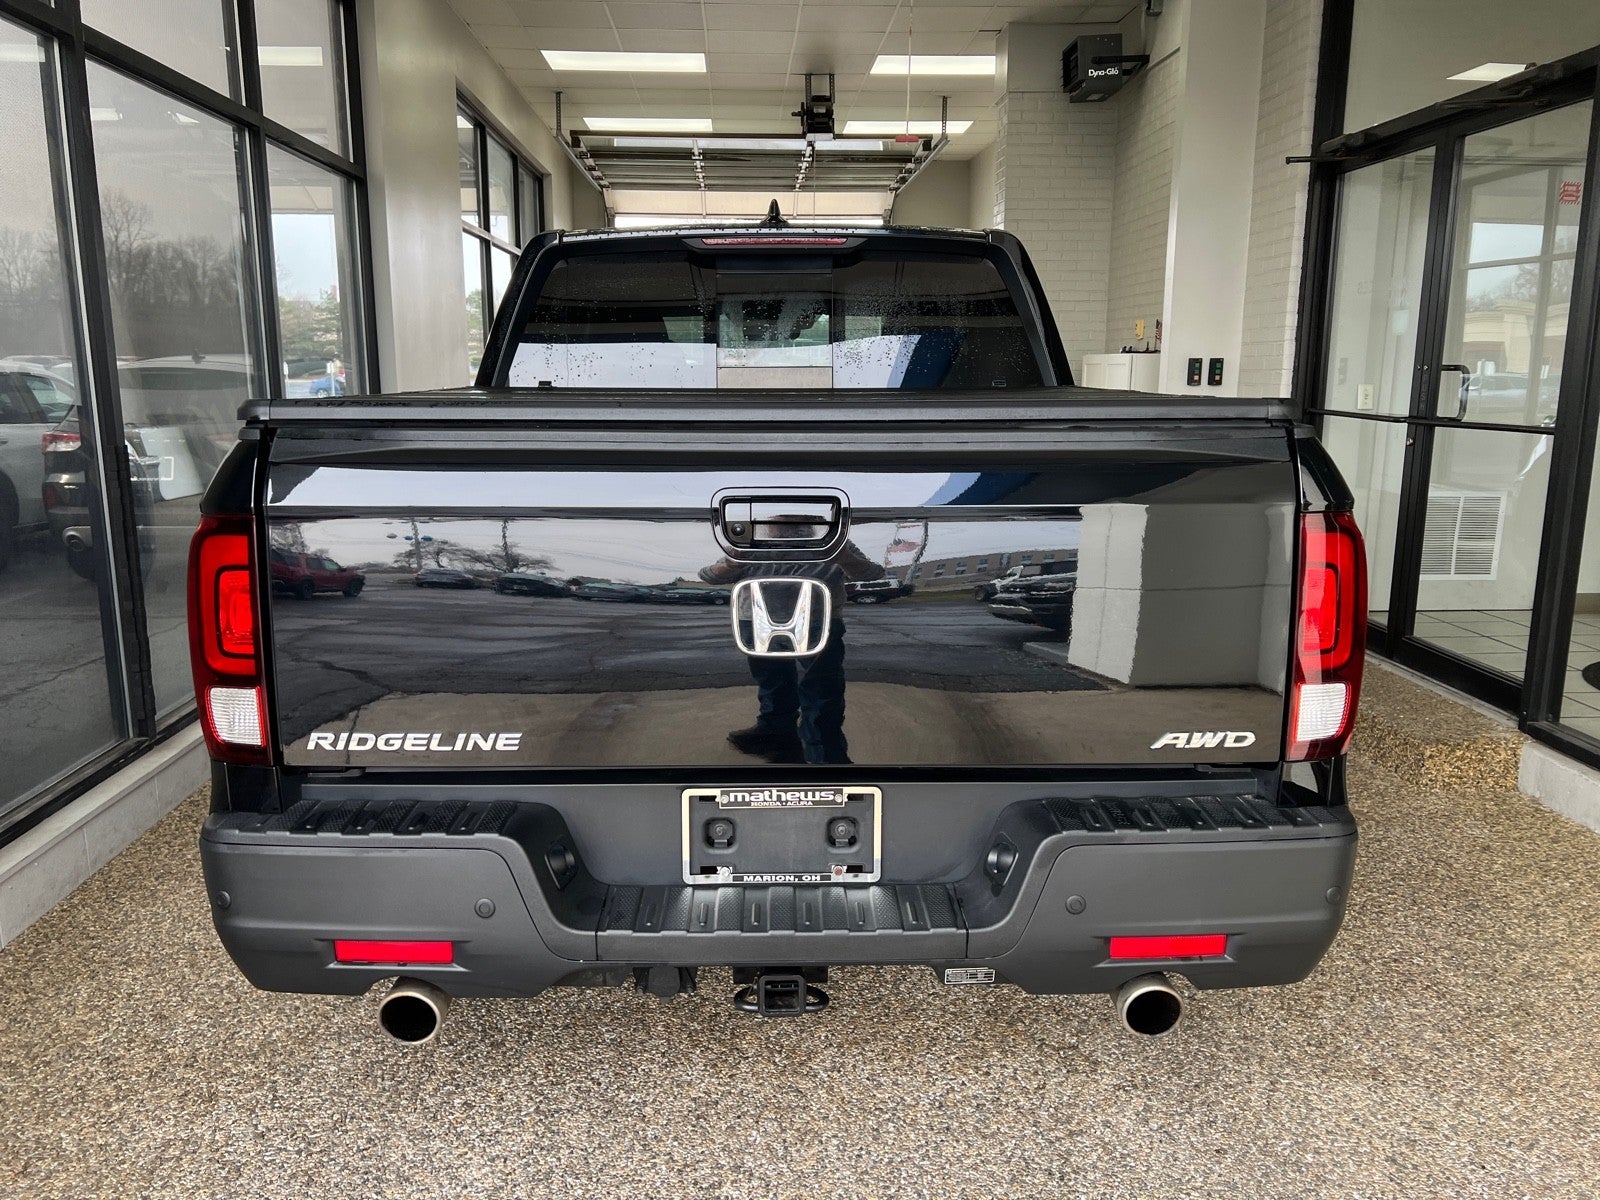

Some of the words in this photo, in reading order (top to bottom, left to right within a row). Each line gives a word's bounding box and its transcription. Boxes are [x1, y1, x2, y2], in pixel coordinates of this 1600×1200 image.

[306, 732, 523, 751] RIDGELINE
[1150, 731, 1256, 749] AWD
[729, 789, 835, 802] mathews
